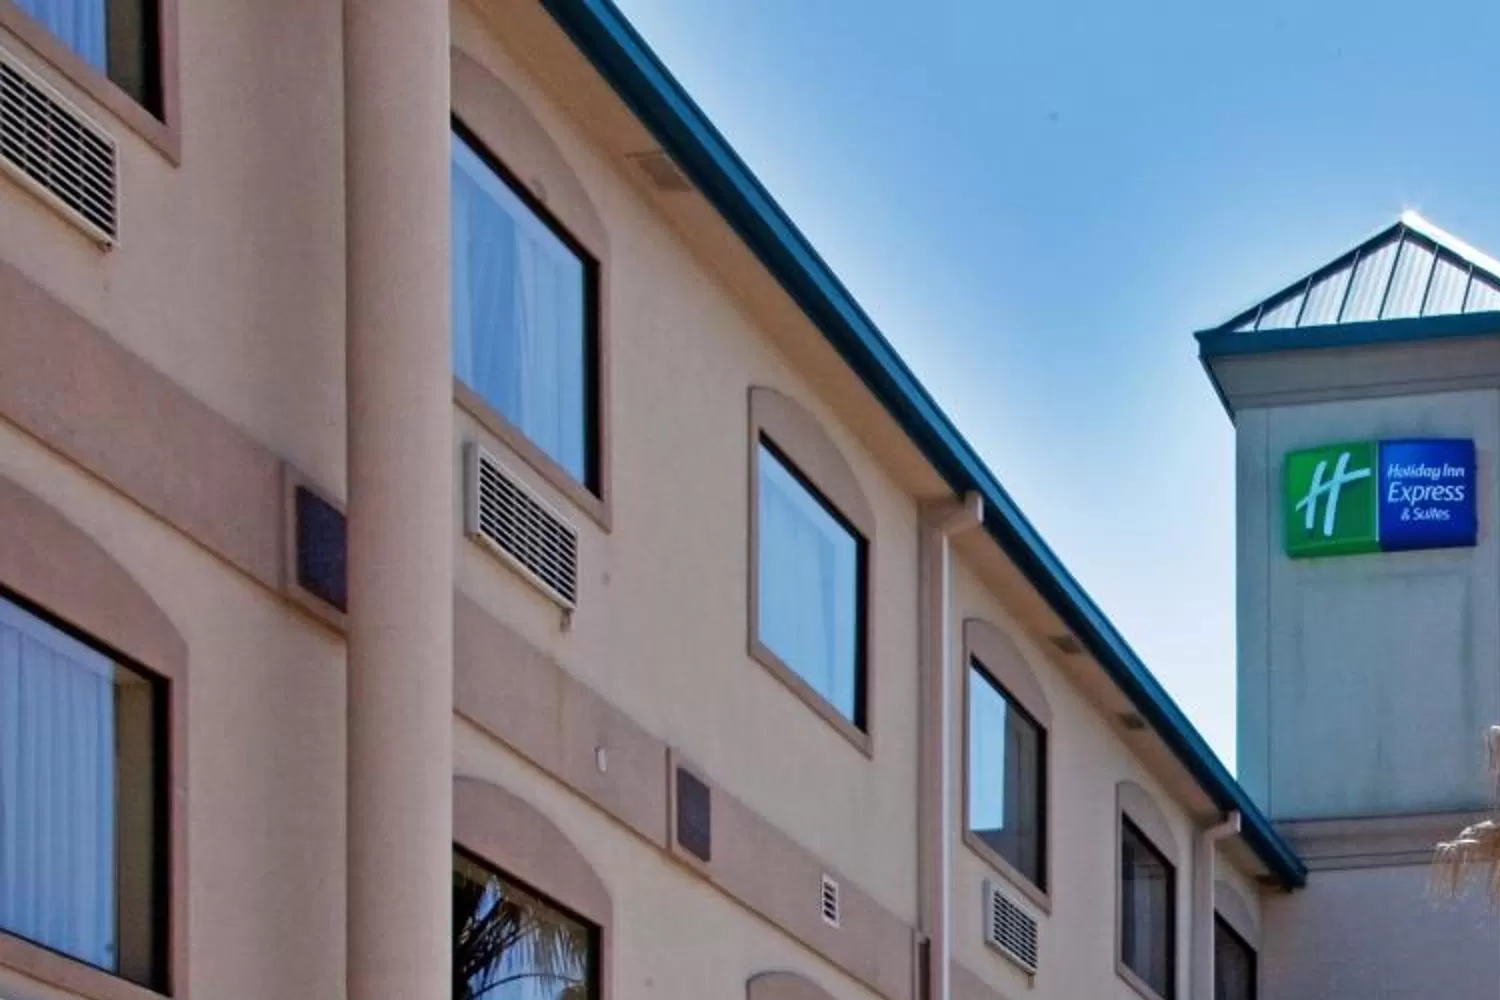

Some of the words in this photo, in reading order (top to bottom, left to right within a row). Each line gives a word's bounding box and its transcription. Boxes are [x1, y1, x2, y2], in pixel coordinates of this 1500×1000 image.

[1387, 463, 1440, 480] Holiday
[1441, 465, 1465, 477] Inn
[1295, 452, 1371, 536] H
[1387, 482, 1465, 505] Express
[1401, 508, 1410, 521] &
[1412, 508, 1450, 520] Suites
